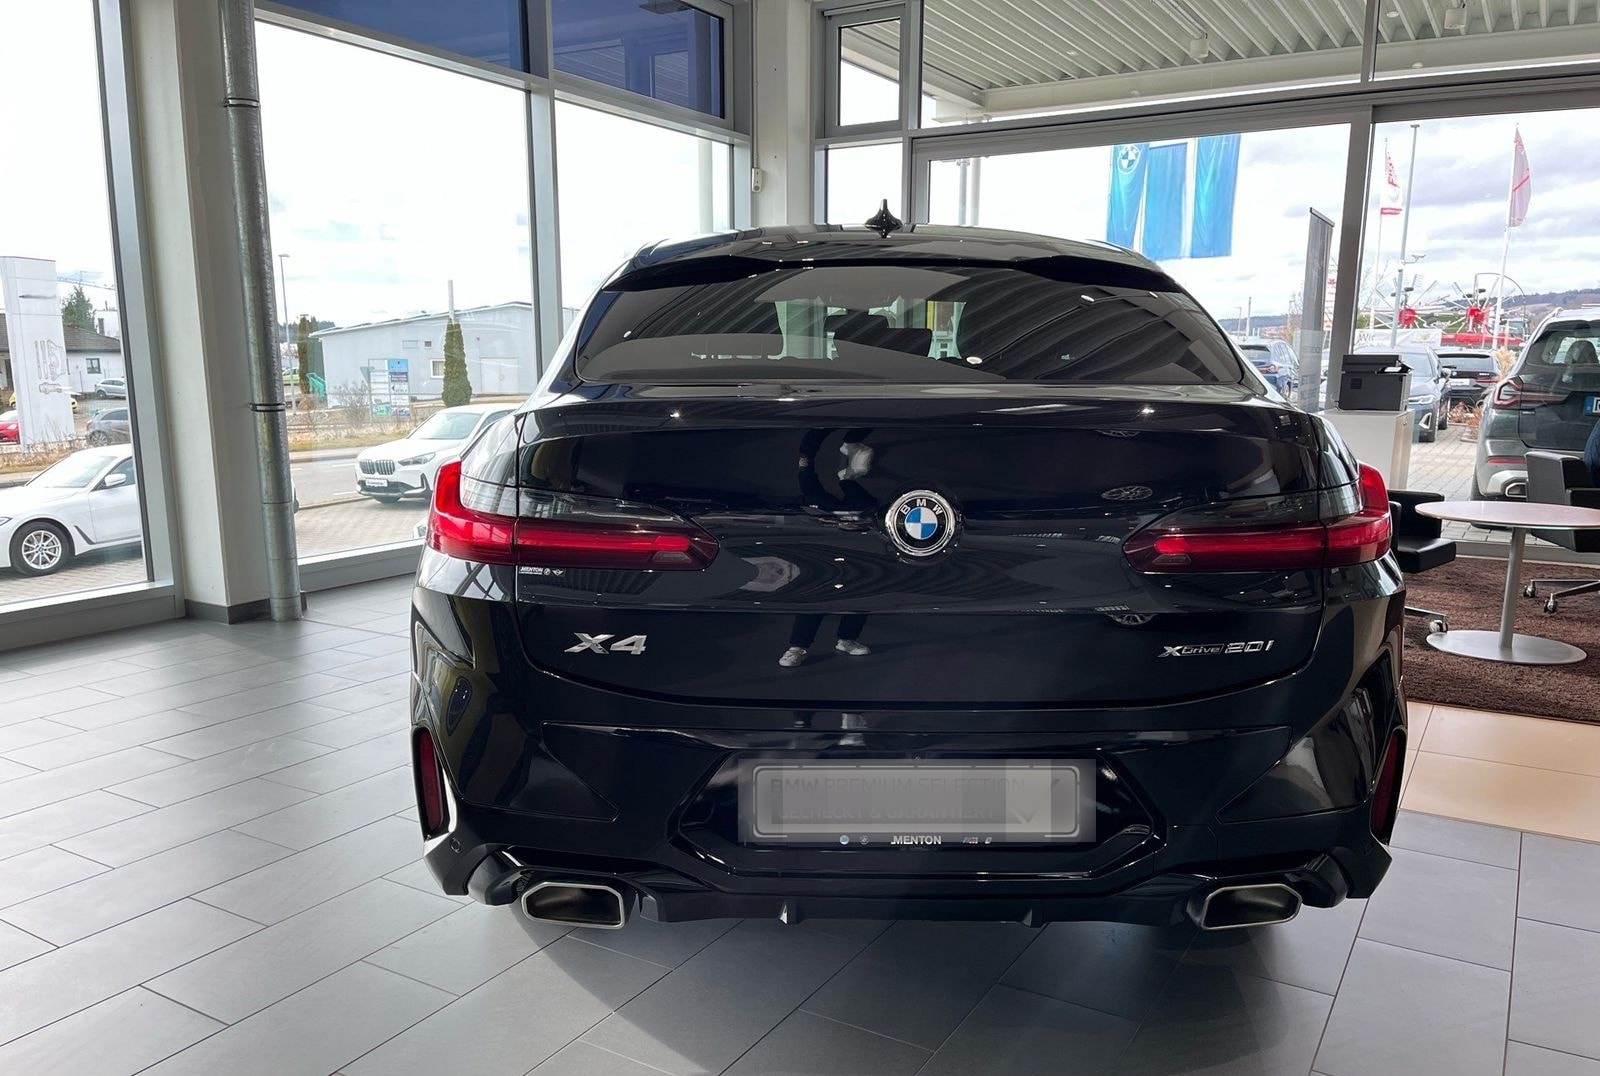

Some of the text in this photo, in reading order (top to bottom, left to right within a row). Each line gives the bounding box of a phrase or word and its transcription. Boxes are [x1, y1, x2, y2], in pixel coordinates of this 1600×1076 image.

[900, 499, 943, 515] BMW
[564, 632, 647, 655] X4
[771, 778, 818, 793] BMW
[891, 835, 942, 845] MENTON
